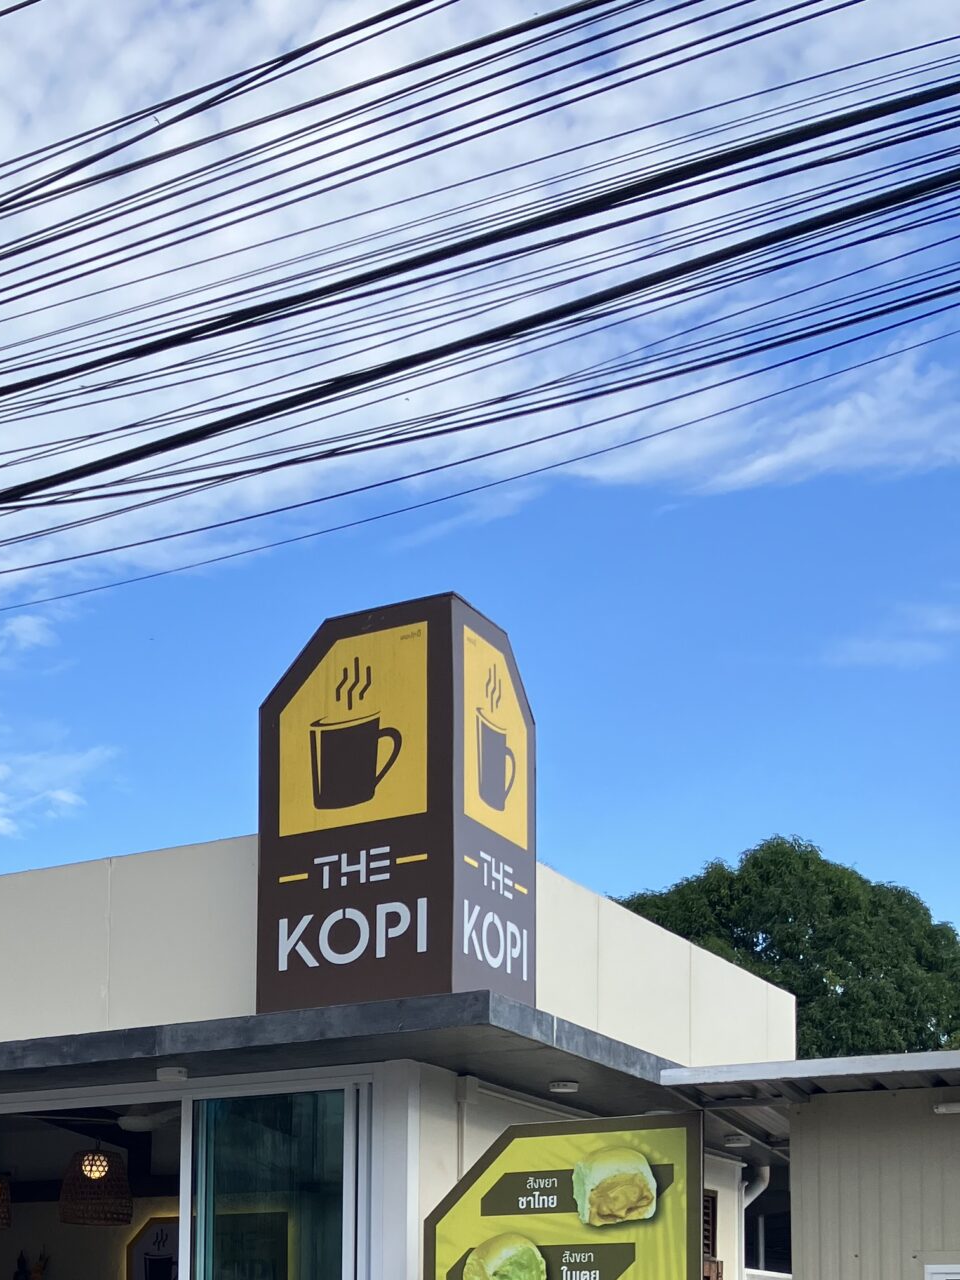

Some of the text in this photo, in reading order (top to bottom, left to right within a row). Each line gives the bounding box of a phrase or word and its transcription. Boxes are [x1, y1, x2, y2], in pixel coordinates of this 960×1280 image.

[313, 845, 391, 890] THE
[479, 850, 514, 900] THE
[277, 896, 428, 973] KOPI
[463, 898, 528, 982] KOPI
[518, 1191, 557, 1209] ชาไทย
[526, 1176, 558, 1189] สังขยา
[562, 1250, 594, 1263] สังขยา
